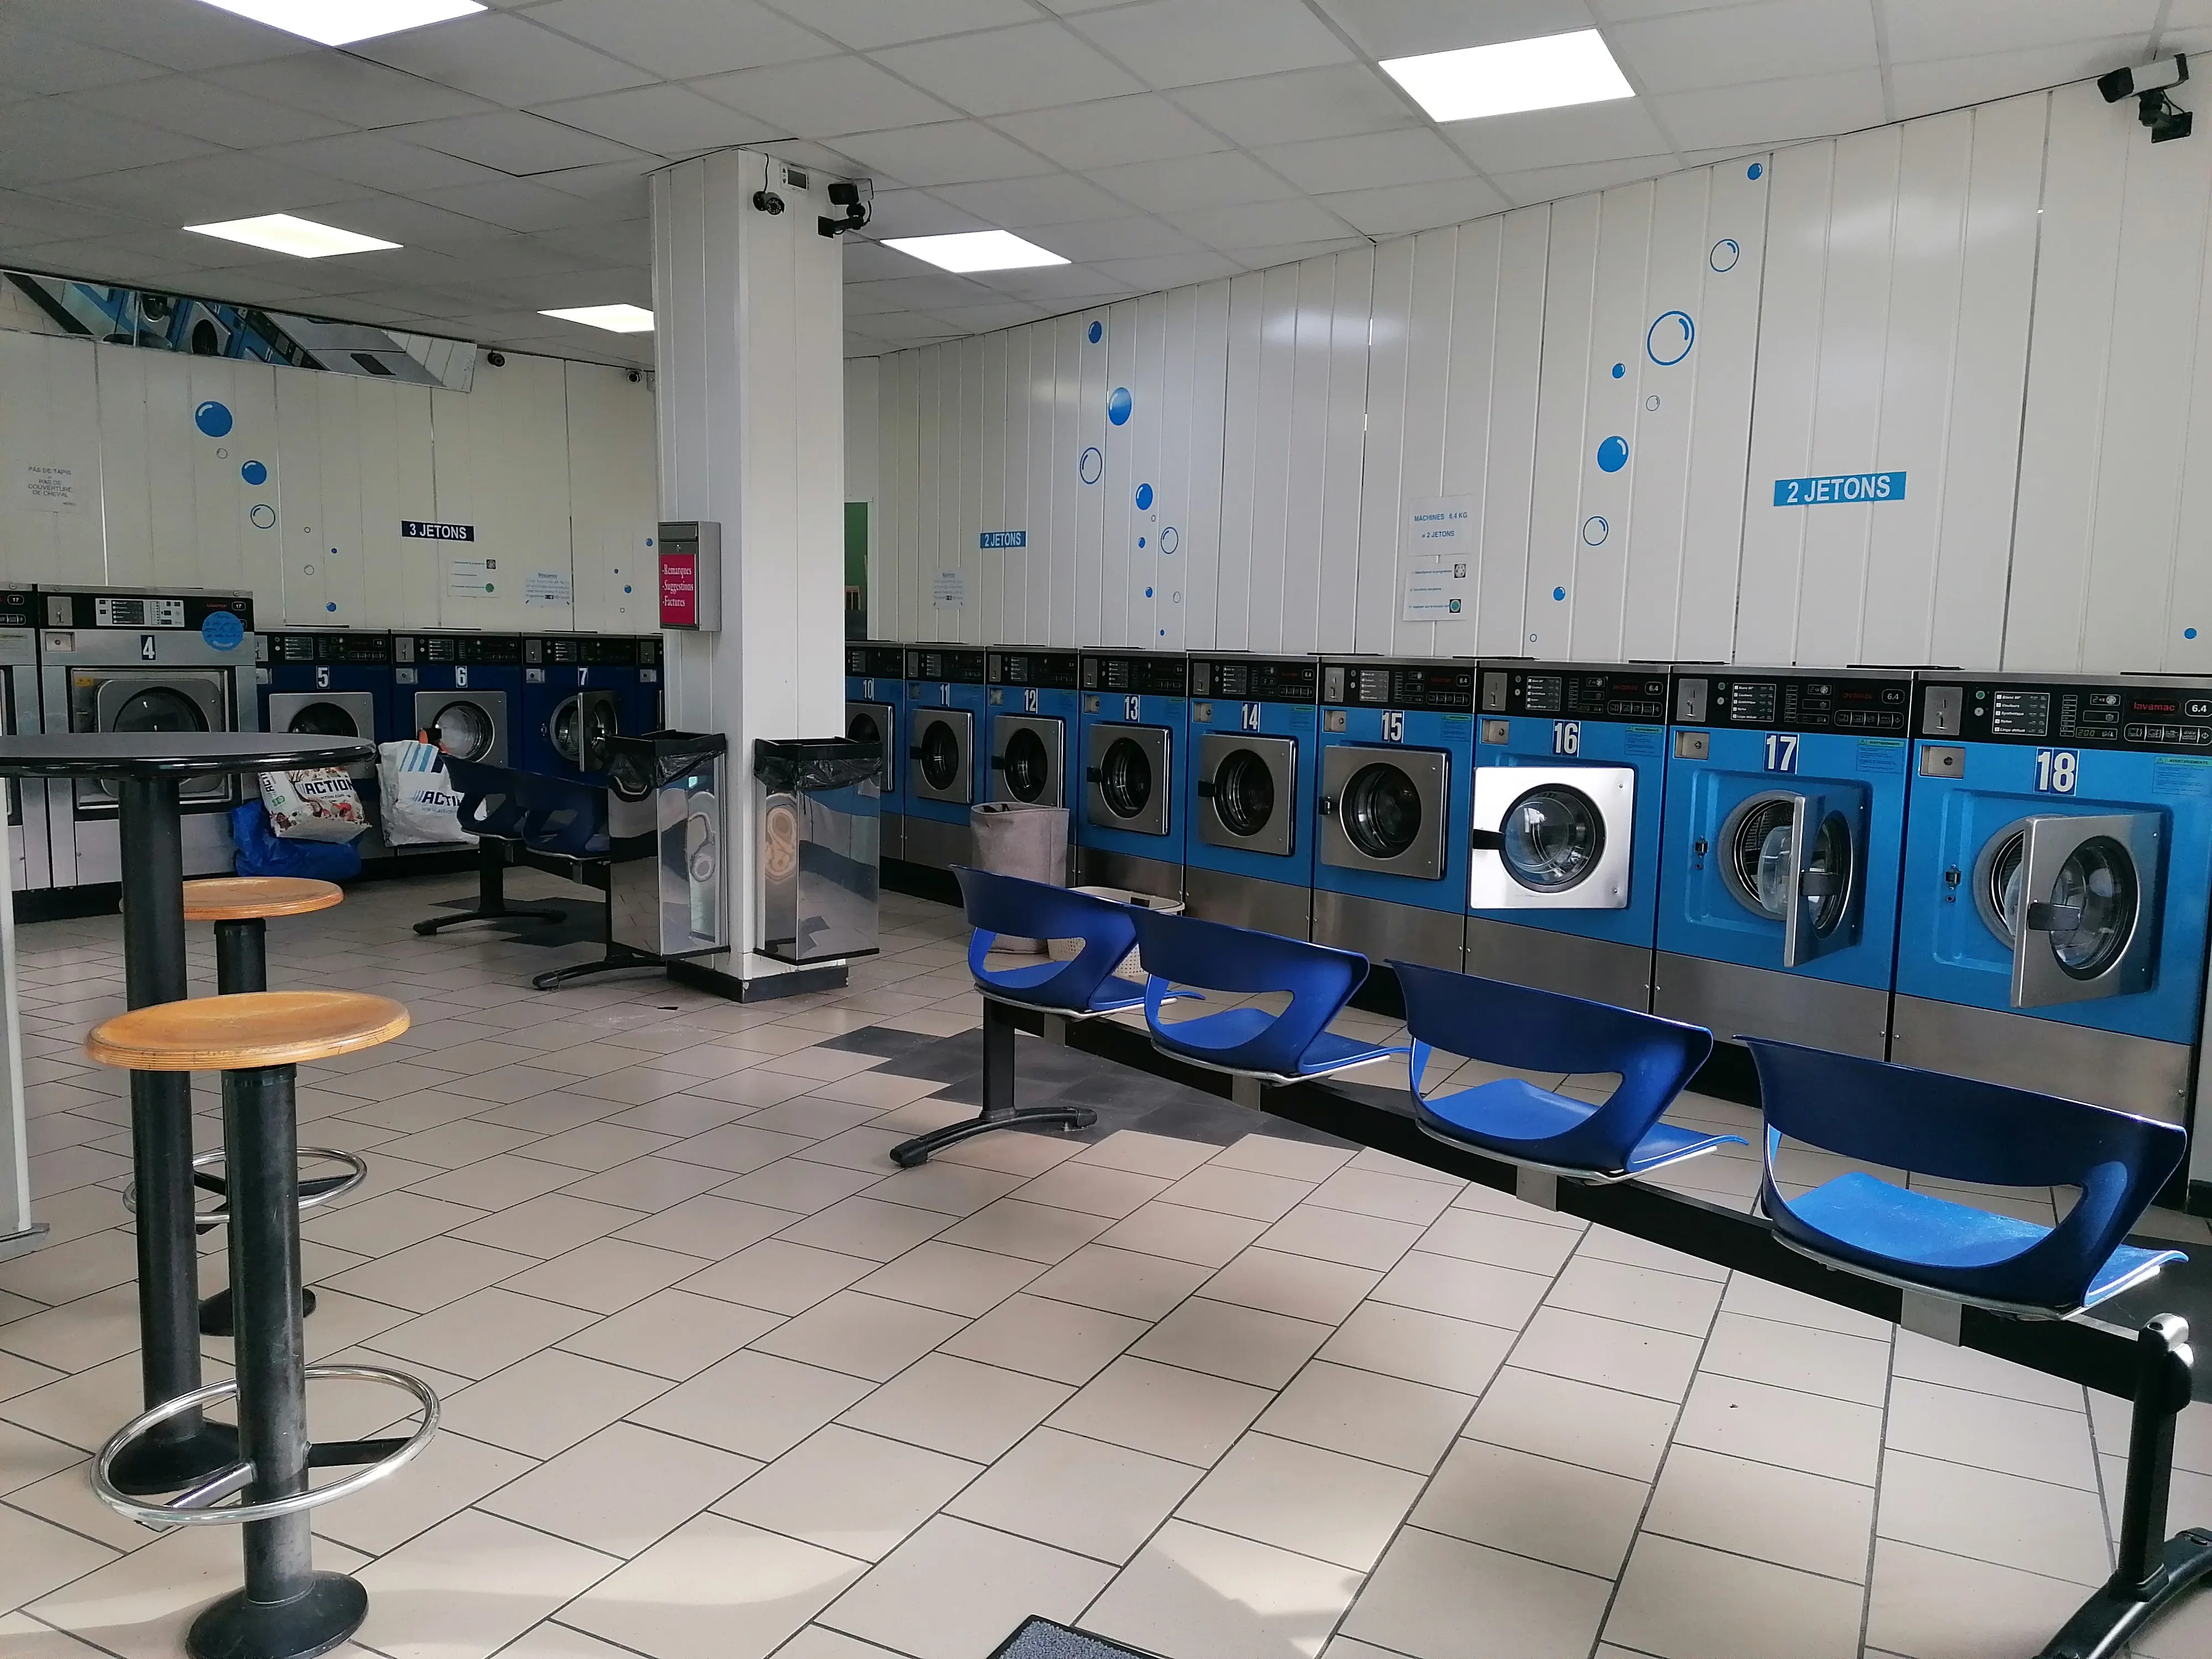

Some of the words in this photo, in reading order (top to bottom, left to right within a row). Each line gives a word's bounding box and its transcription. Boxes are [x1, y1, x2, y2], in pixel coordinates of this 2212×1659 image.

[1787, 482, 1799, 503] 2
[1804, 475, 1891, 502] JETONS
[409, 523, 416, 536] 3
[419, 524, 467, 539] JETONS
[984, 534, 989, 547] 2
[990, 532, 1021, 546] JETONS
[143, 637, 155, 659] 4
[317, 667, 328, 687] 5
[457, 667, 466, 686] 6
[579, 667, 588, 686] 7
[863, 679, 873, 699] 10
[940, 684, 948, 705] 11
[1025, 689, 1036, 712] 12
[1124, 696, 1139, 720] 13
[2133, 702, 2176, 711] lavamac
[1242, 704, 1258, 729] 14
[1382, 712, 1402, 741] 15
[1554, 722, 1578, 754] 16
[1766, 735, 1797, 771] 17
[2038, 751, 2076, 792] 18
